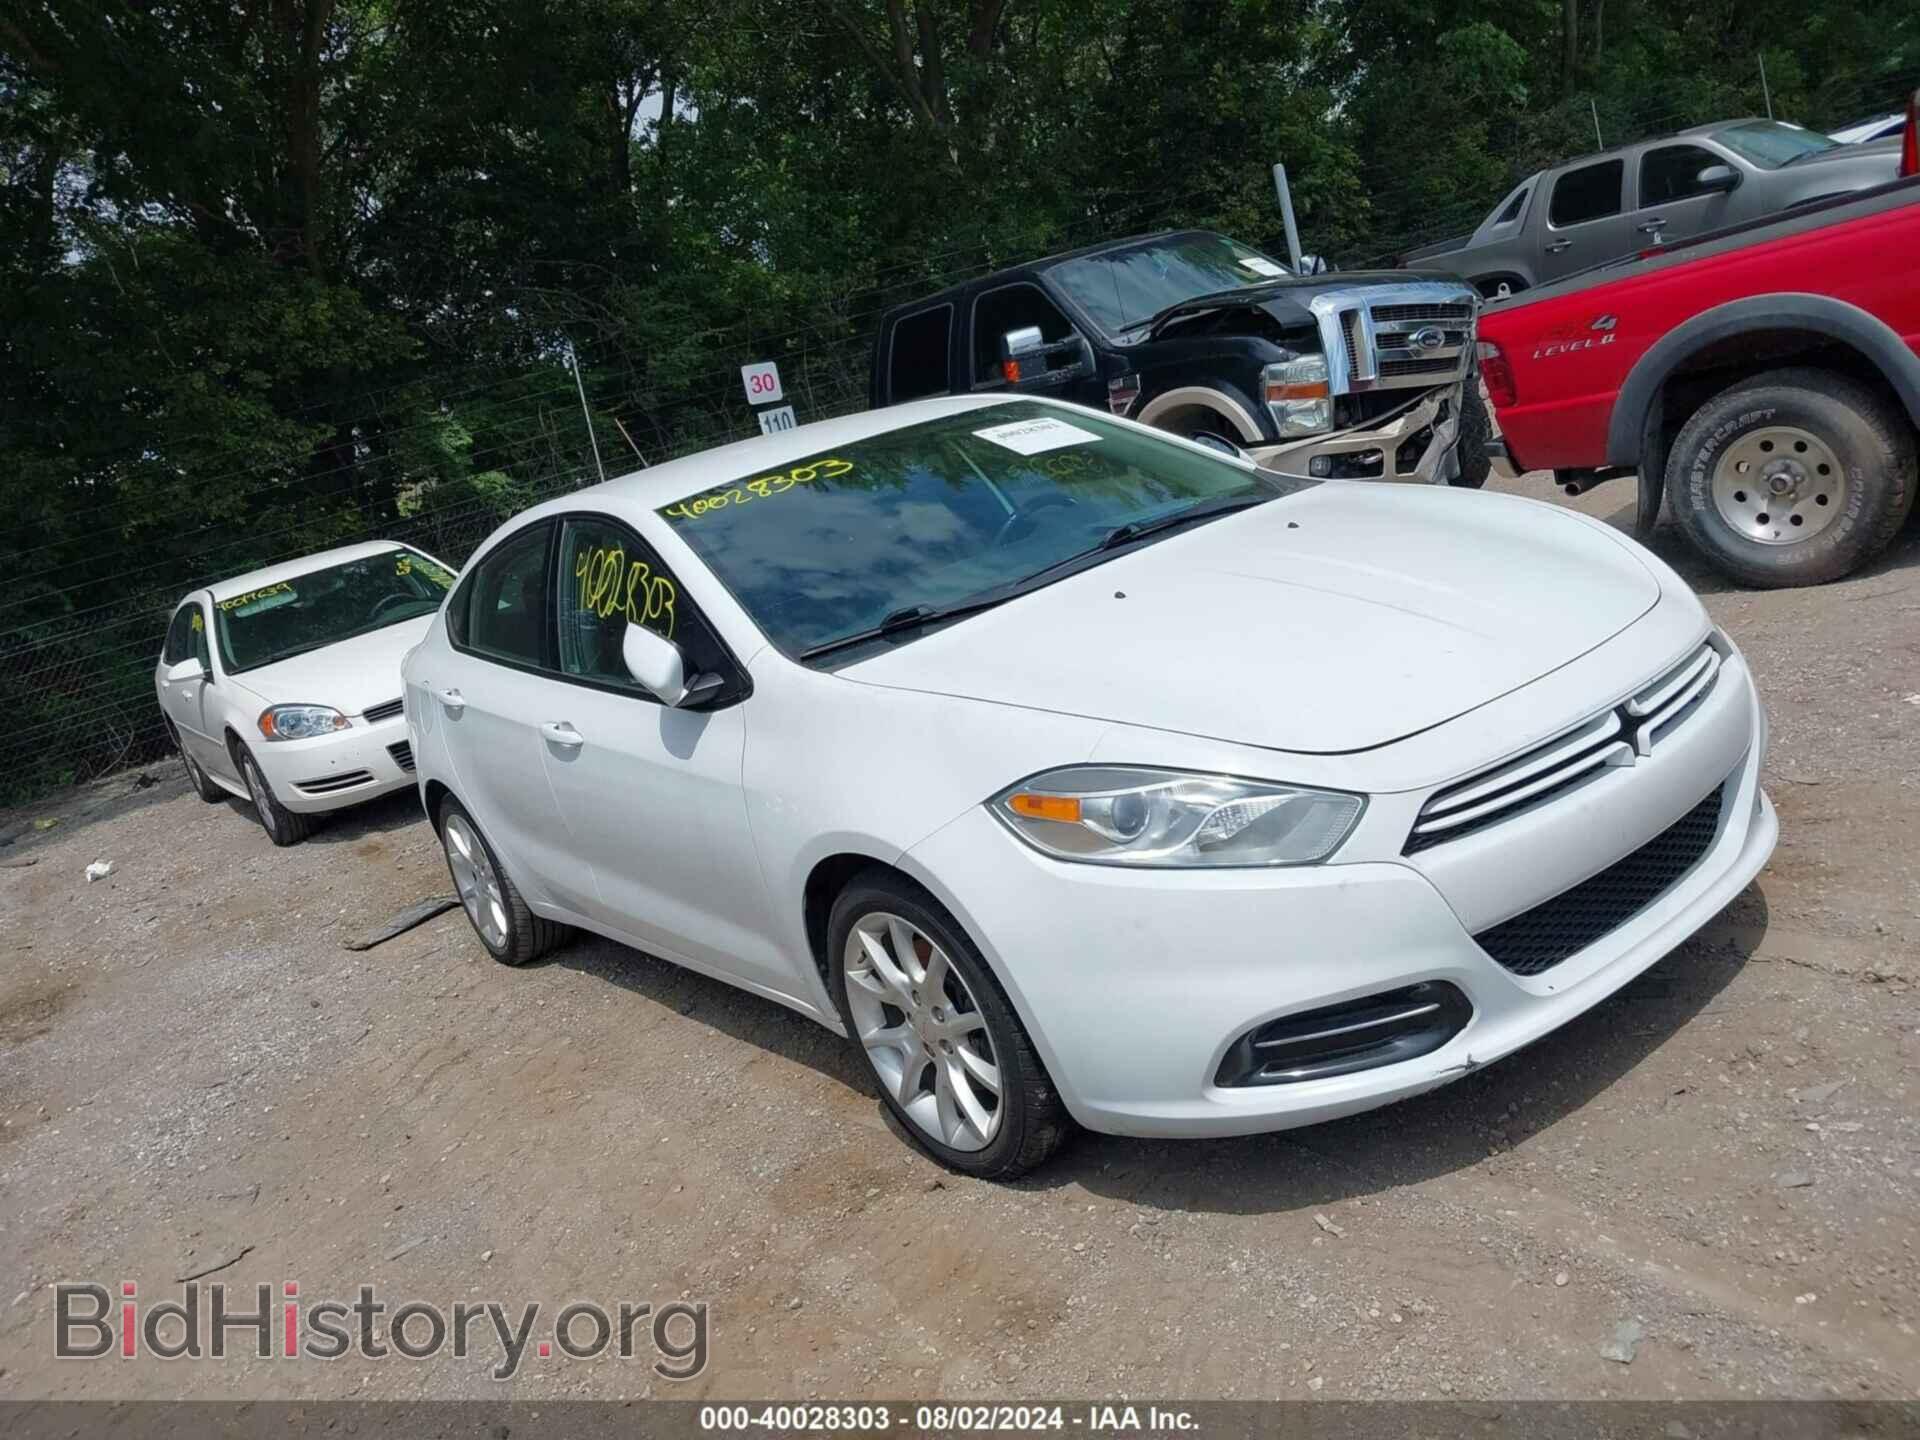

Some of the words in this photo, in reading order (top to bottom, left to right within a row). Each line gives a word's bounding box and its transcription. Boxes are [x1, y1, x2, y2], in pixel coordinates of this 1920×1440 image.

[1533, 338, 1593, 360] LEVEL
[750, 373, 776, 394] 30
[764, 411, 793, 434] 110
[666, 459, 853, 519] 40028303
